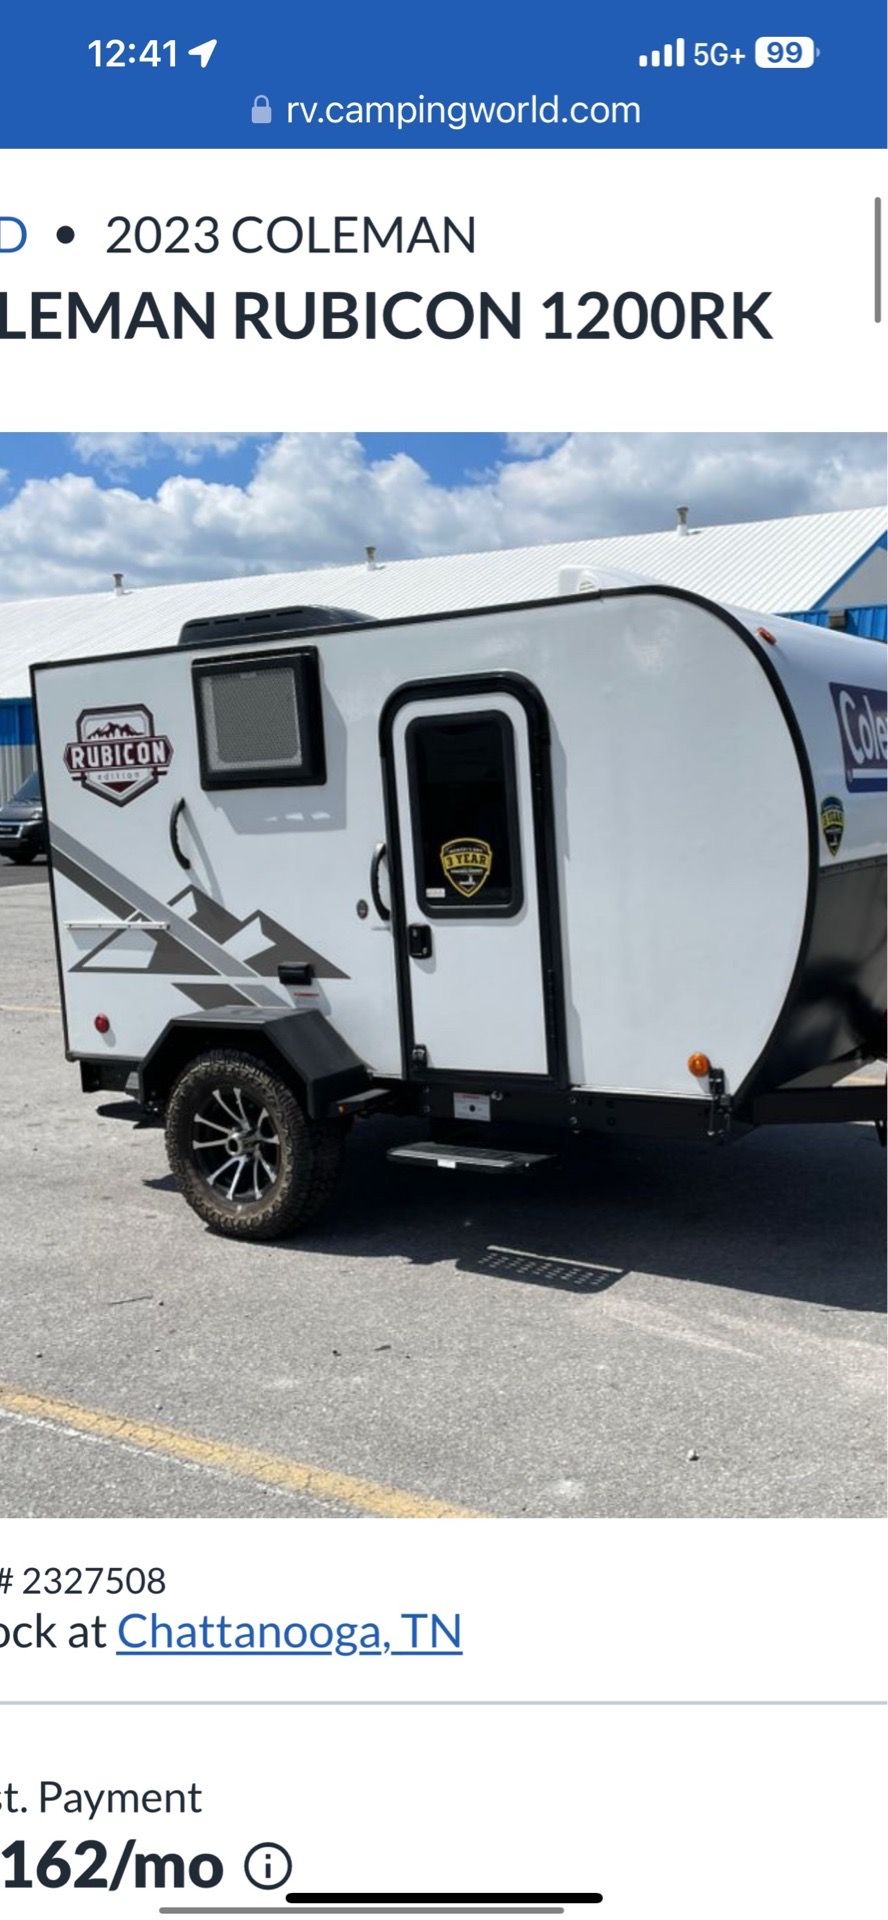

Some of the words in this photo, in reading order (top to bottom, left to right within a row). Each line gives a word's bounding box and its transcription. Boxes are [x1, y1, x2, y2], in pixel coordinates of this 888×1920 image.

[89, 38, 176, 68] 12:41
[694, 42, 746, 67] 5G+
[766, 41, 803, 64] 99
[287, 95, 641, 131] rv.campingworld.com
[106, 215, 220, 254] 2023
[231, 215, 475, 254] COLEMAN
[0, 290, 215, 340] LEMAN
[235, 290, 521, 340] RUBICON
[541, 290, 774, 340] 1200RK
[70, 737, 166, 769] RUBICON
[455, 853, 487, 865] YEAR
[22, 1567, 166, 1595] 2327508
[68, 1616, 108, 1649] at
[117, 1612, 391, 1657] Chattanooga,
[400, 1613, 460, 1648] TN
[40, 1780, 203, 1821] Payment
[1, 1838, 224, 1892] 162/mo
